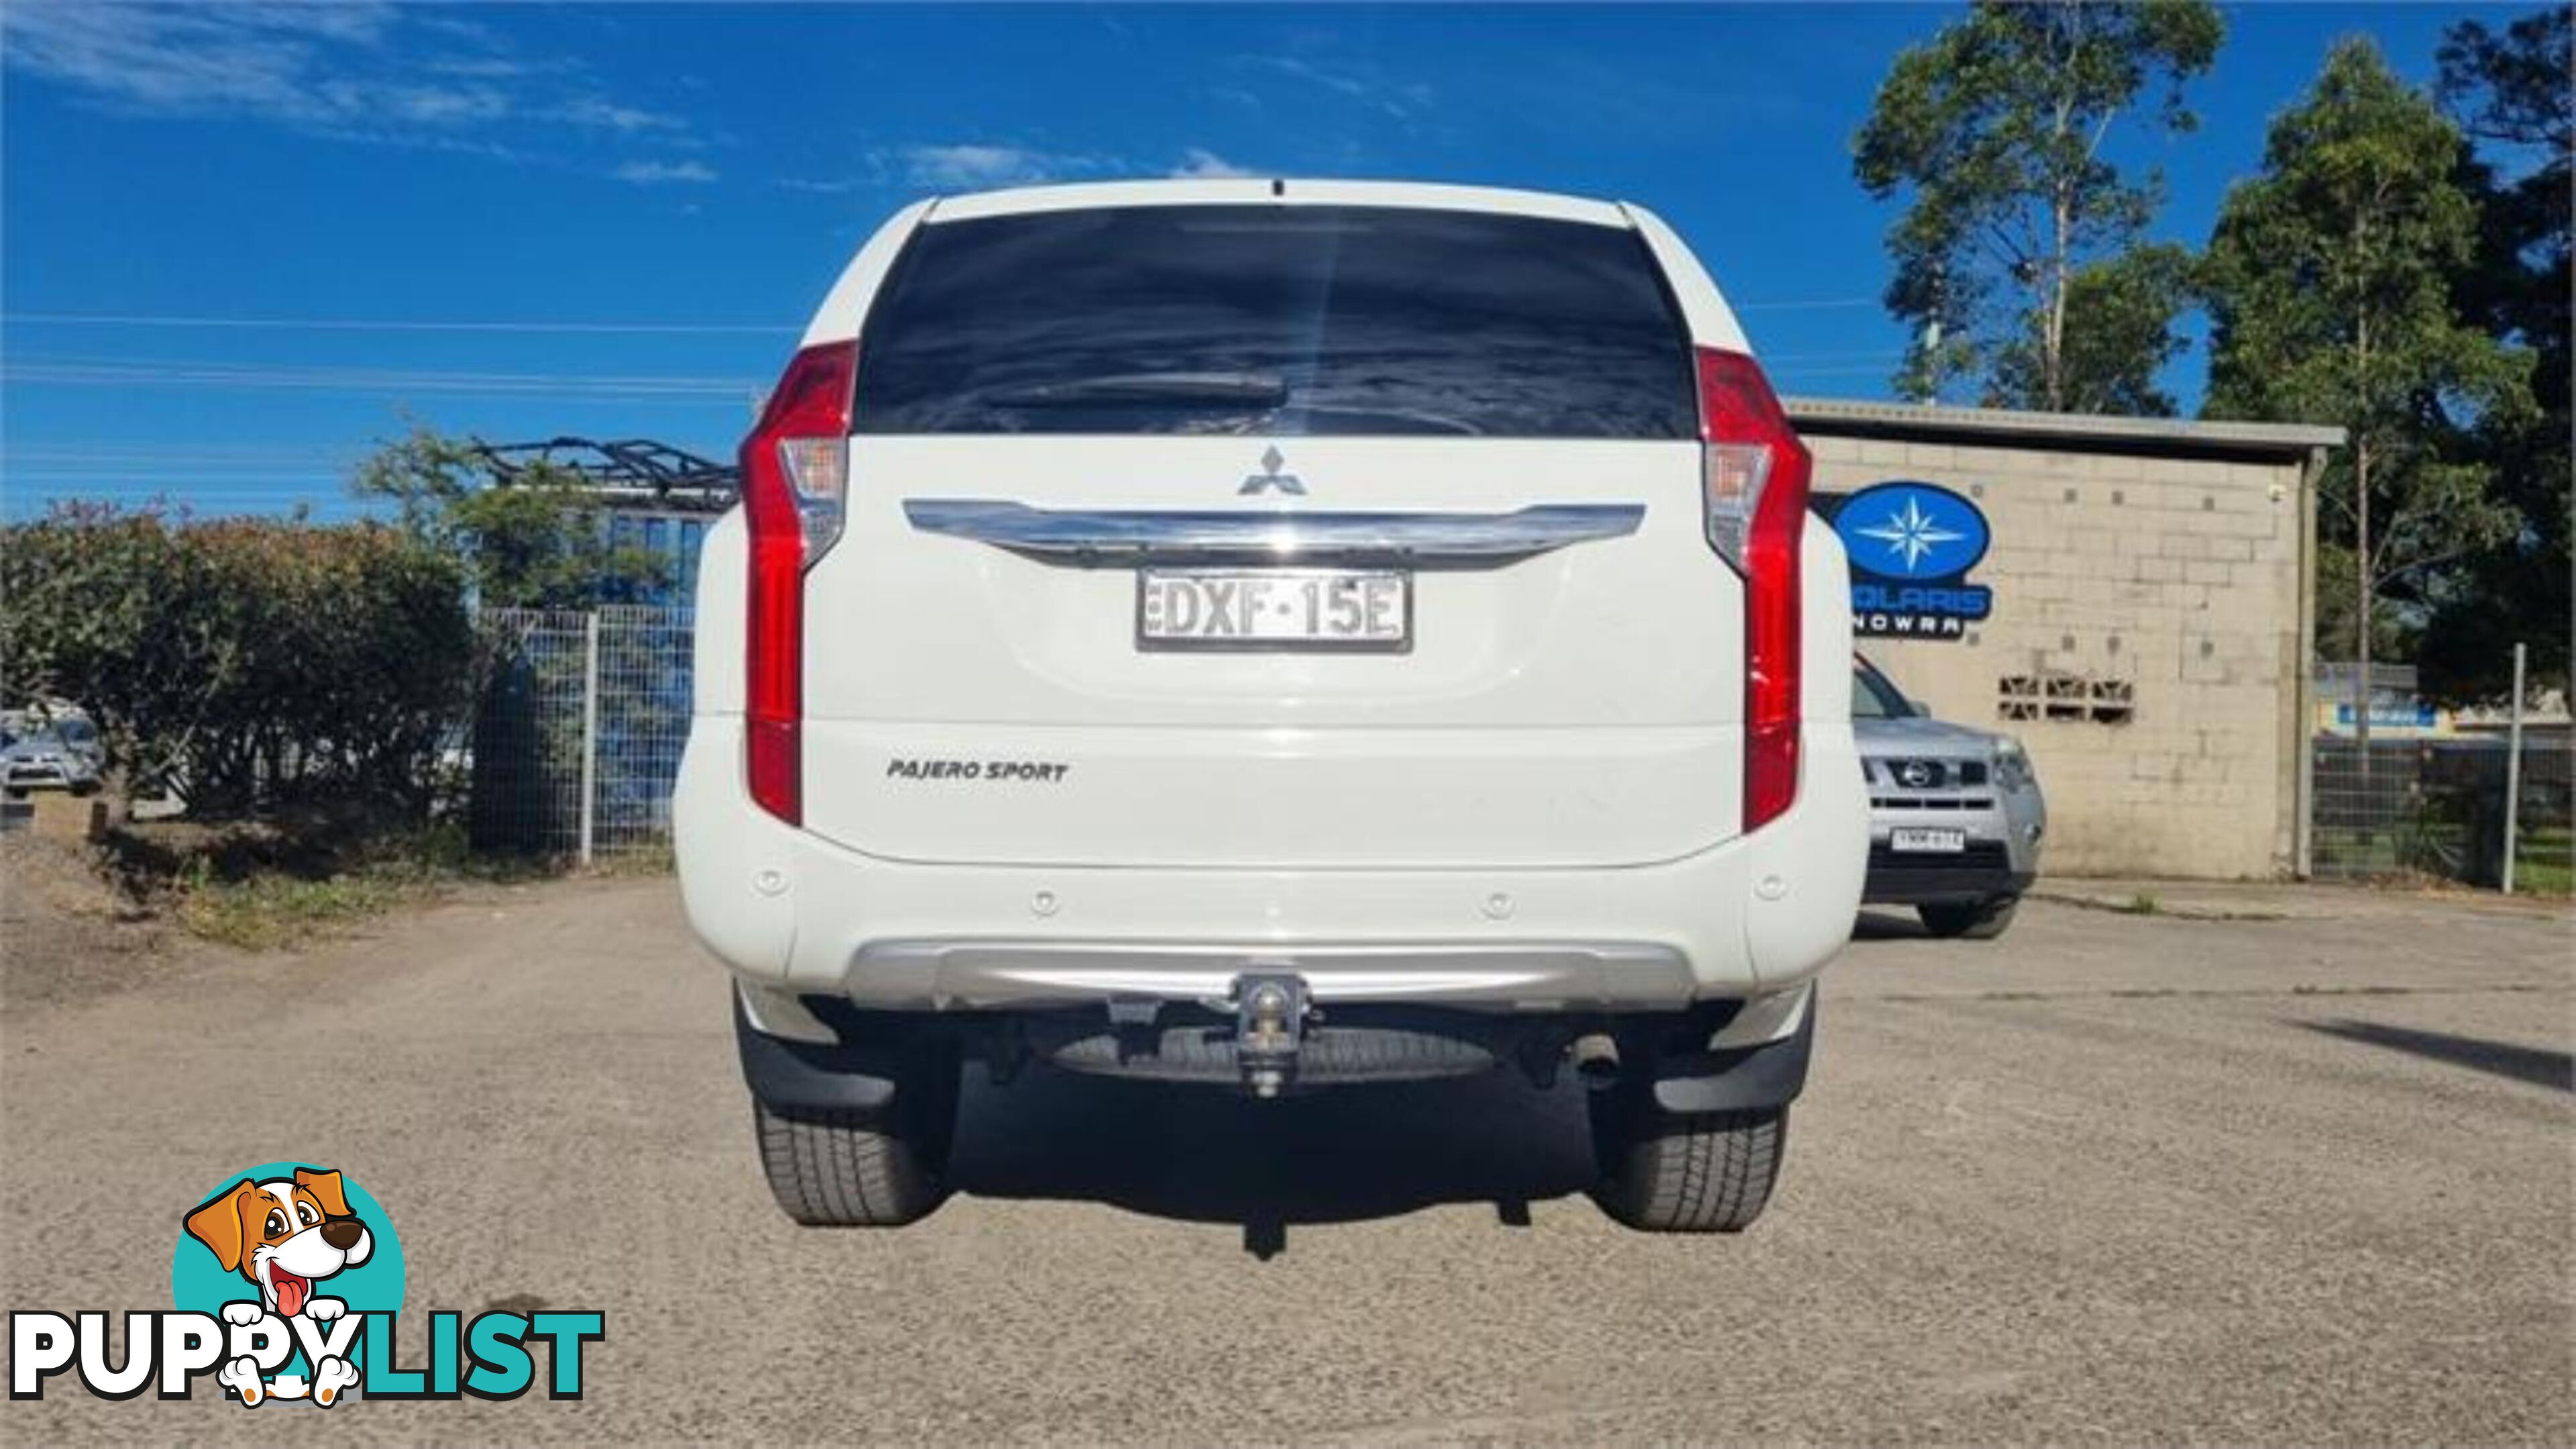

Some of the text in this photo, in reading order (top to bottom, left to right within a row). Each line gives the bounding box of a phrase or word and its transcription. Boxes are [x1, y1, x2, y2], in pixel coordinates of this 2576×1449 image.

[1853, 584, 1987, 616] OLARIS
[887, 759, 1069, 782] PAJERO SPORT
